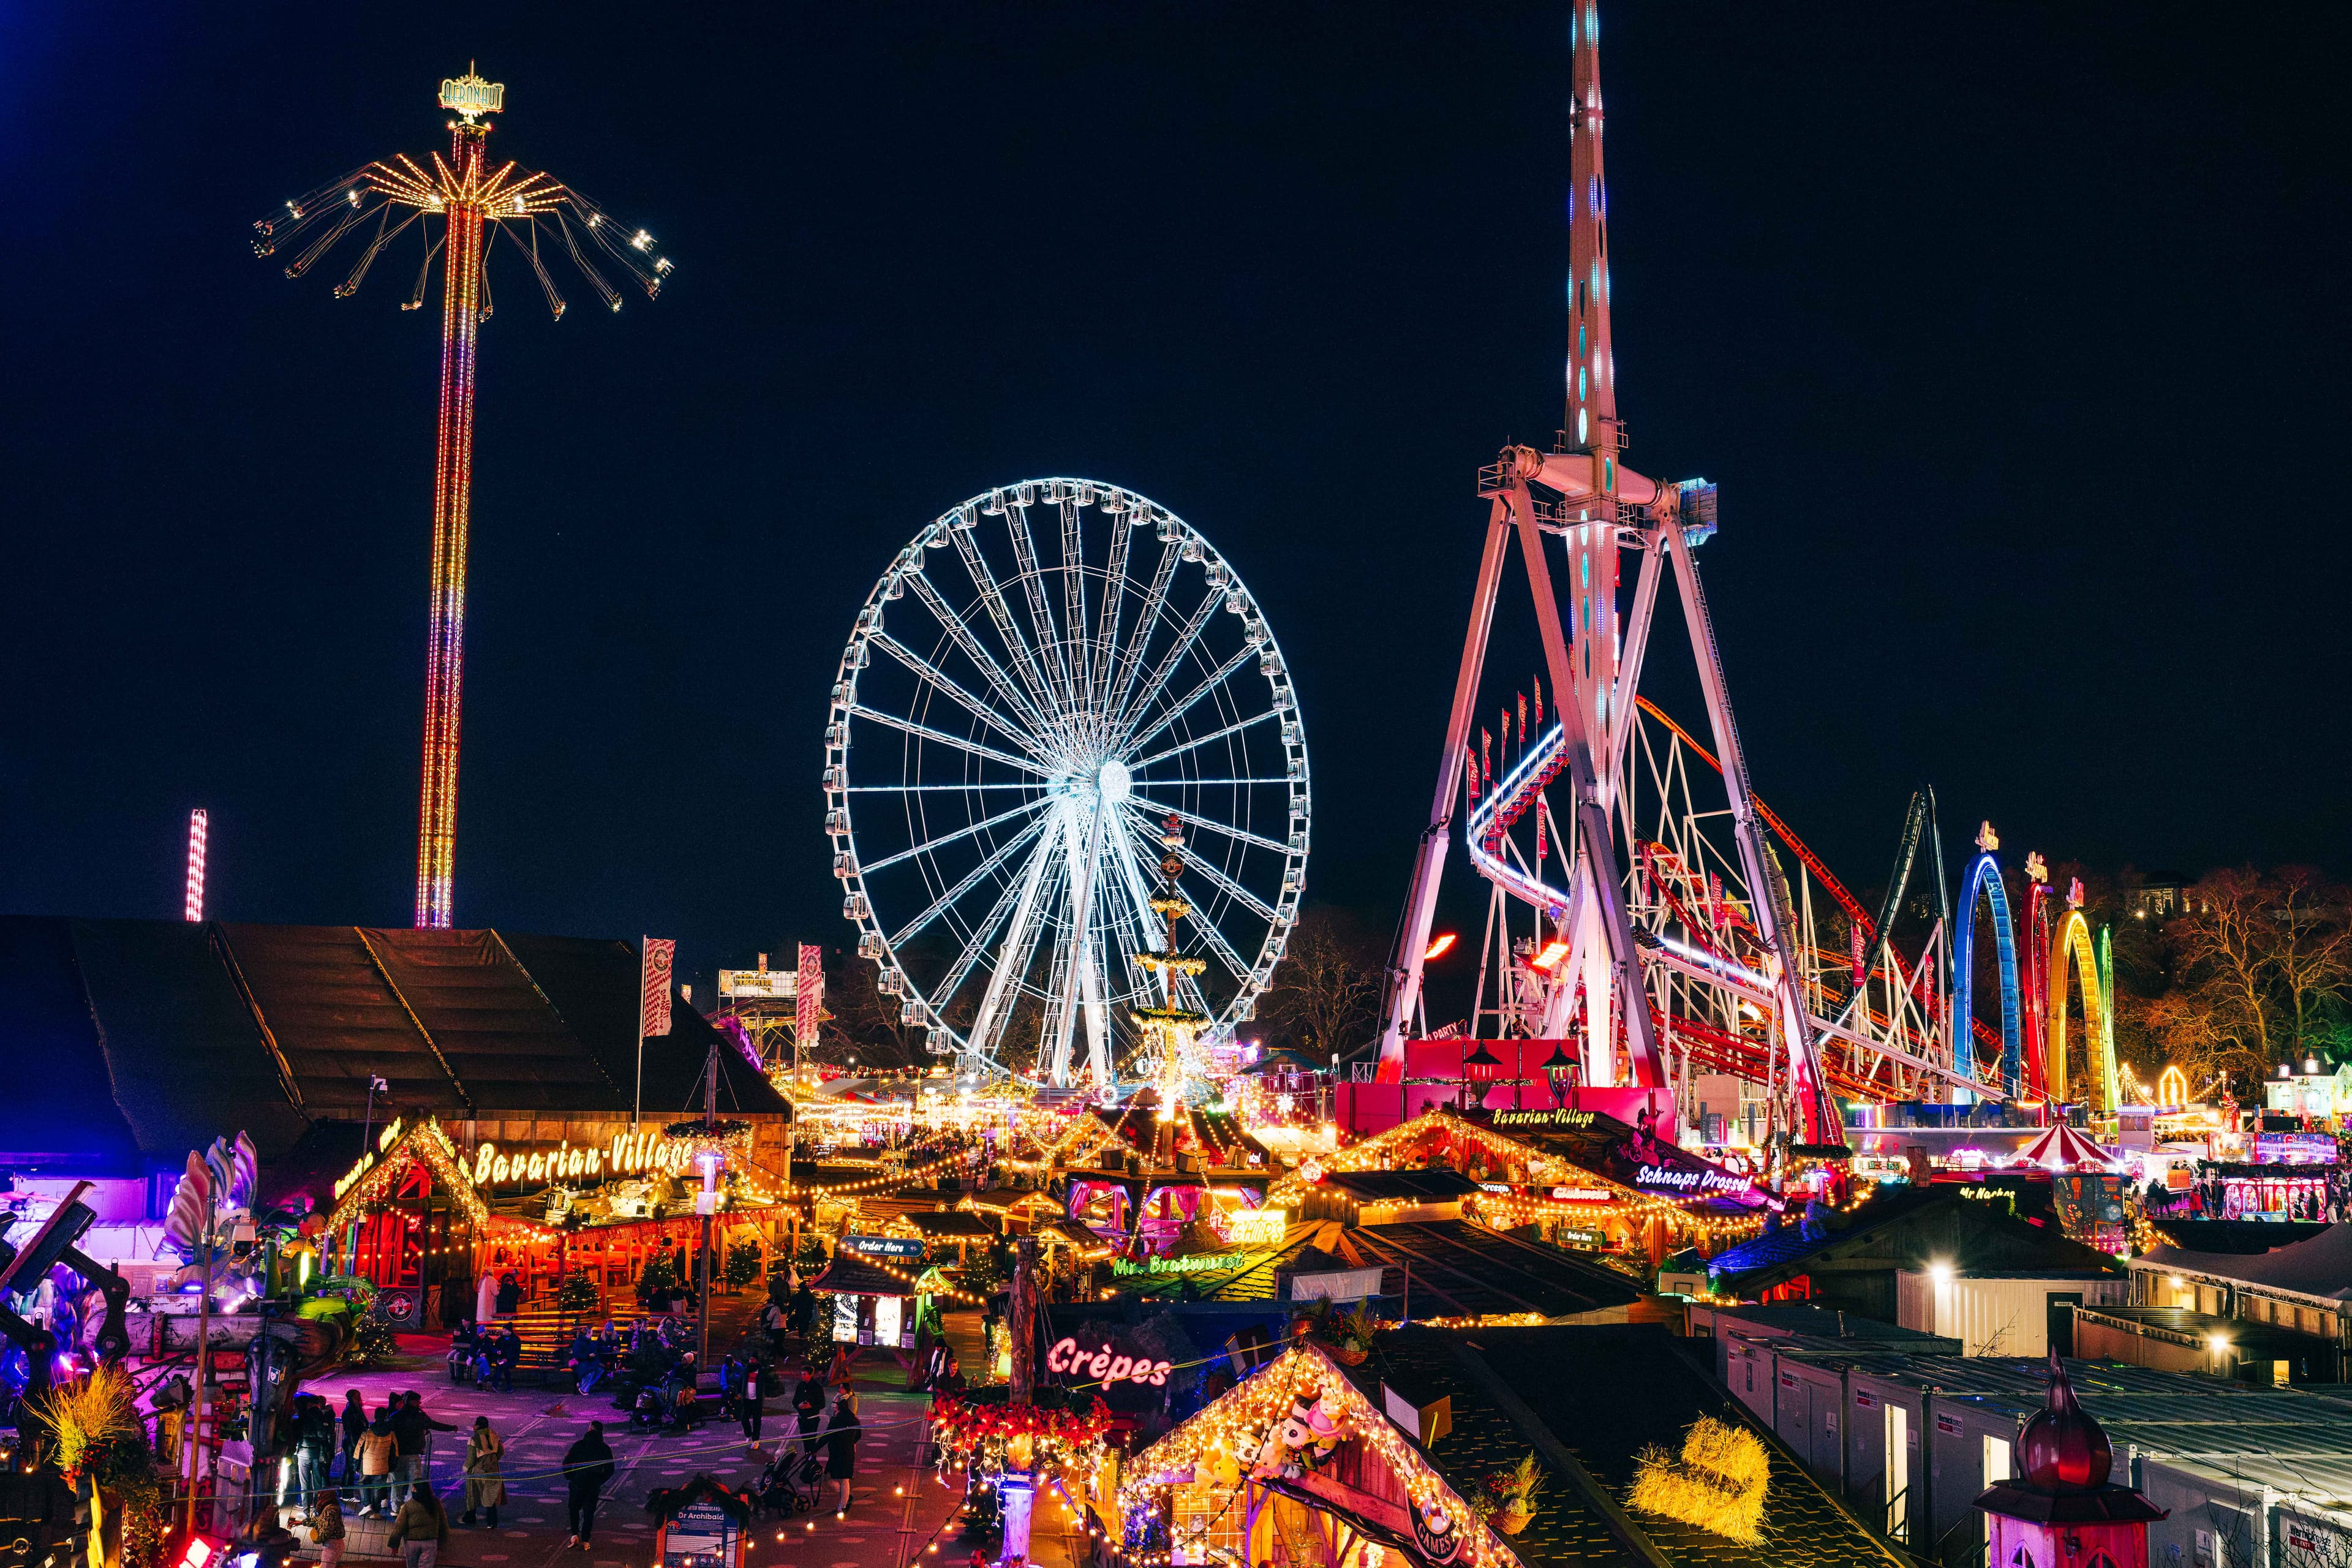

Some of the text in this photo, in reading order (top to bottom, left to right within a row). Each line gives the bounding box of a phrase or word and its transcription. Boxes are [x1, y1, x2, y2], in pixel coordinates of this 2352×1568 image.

[442, 81, 502, 107] AERONAUT
[1433, 1022, 1457, 1041] PARTY
[1636, 1166, 1753, 1192] Schnaps Drossel
[1960, 1188, 1975, 1199] Mr
[1232, 1220, 1285, 1243] CHIPS
[1567, 1231, 1592, 1242] Order Here
[859, 1241, 903, 1252] Order Here
[1150, 1250, 1245, 1273] Bratwurst
[1418, 1523, 1451, 1554] GAMES
